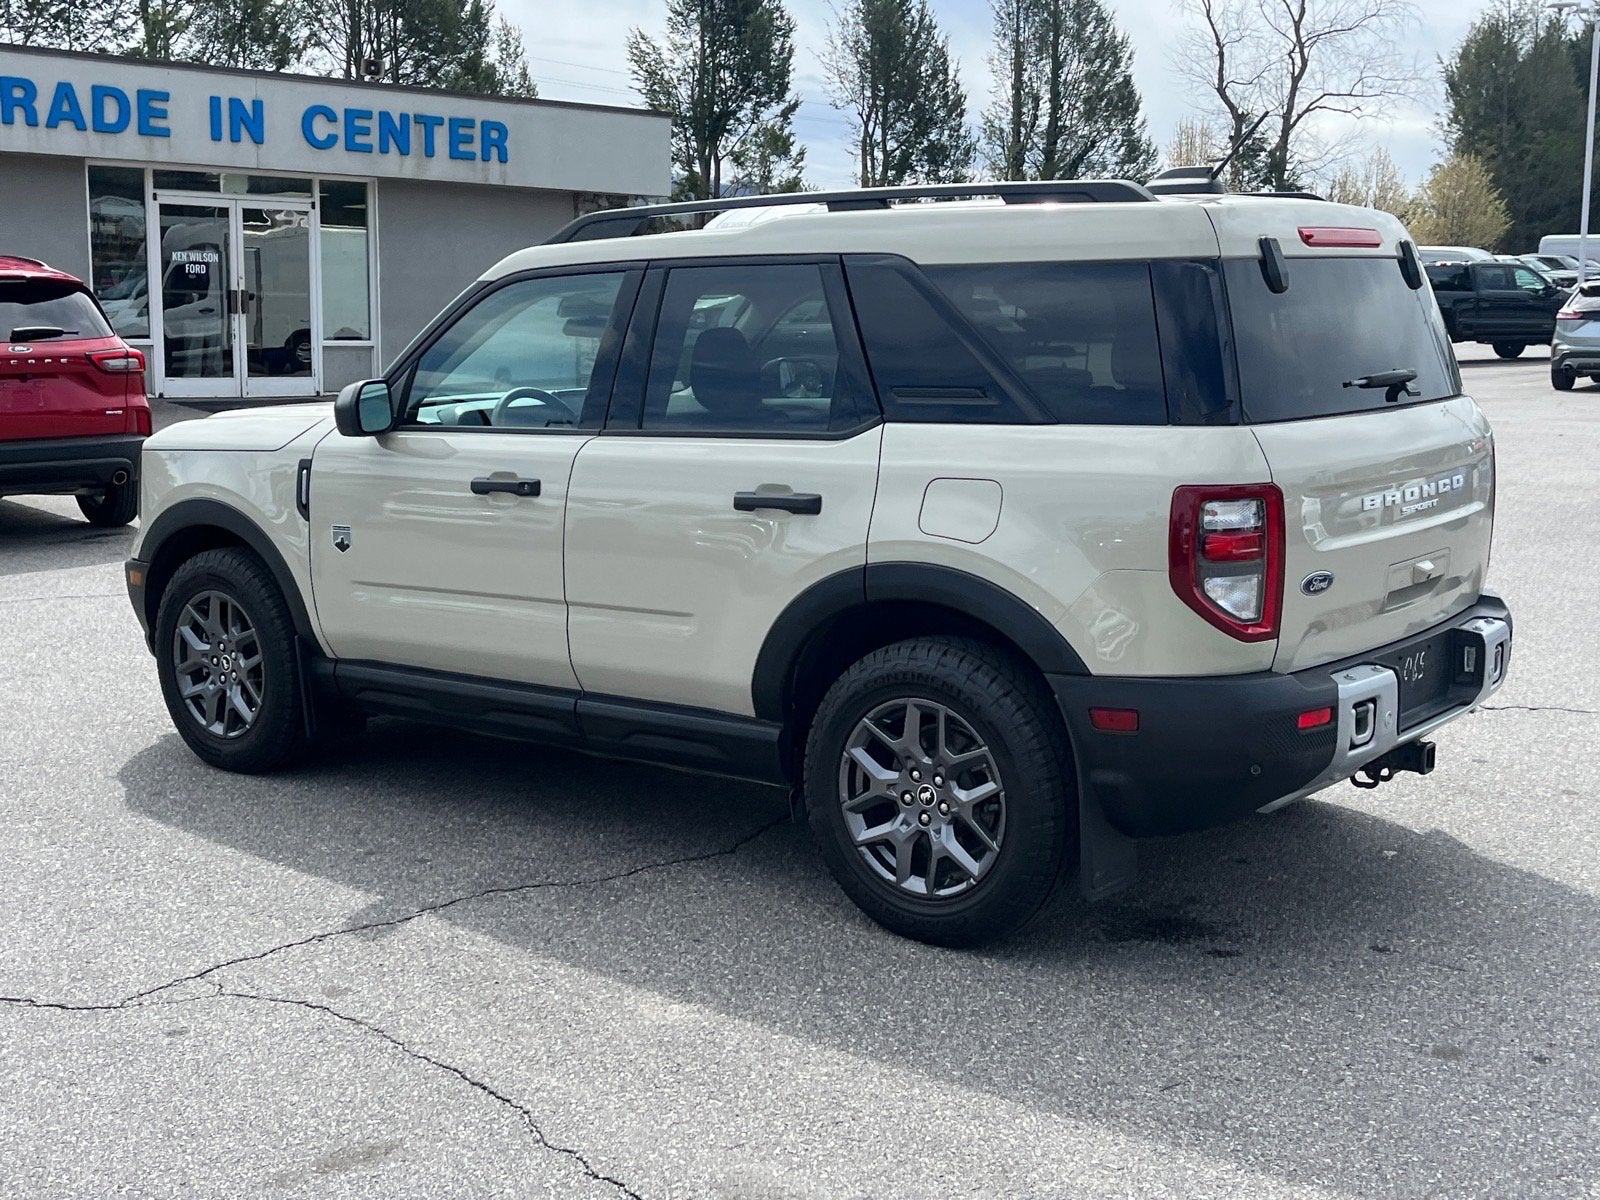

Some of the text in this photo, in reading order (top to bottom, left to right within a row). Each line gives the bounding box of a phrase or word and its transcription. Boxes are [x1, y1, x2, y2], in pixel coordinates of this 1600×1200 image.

[209, 95, 264, 145] IN
[301, 104, 509, 163] CENTER
[172, 251, 219, 263] KEN WILSON
[185, 263, 206, 274] FORD
[1361, 474, 1464, 511] BRONCO
[1400, 498, 1439, 515] SPORT
